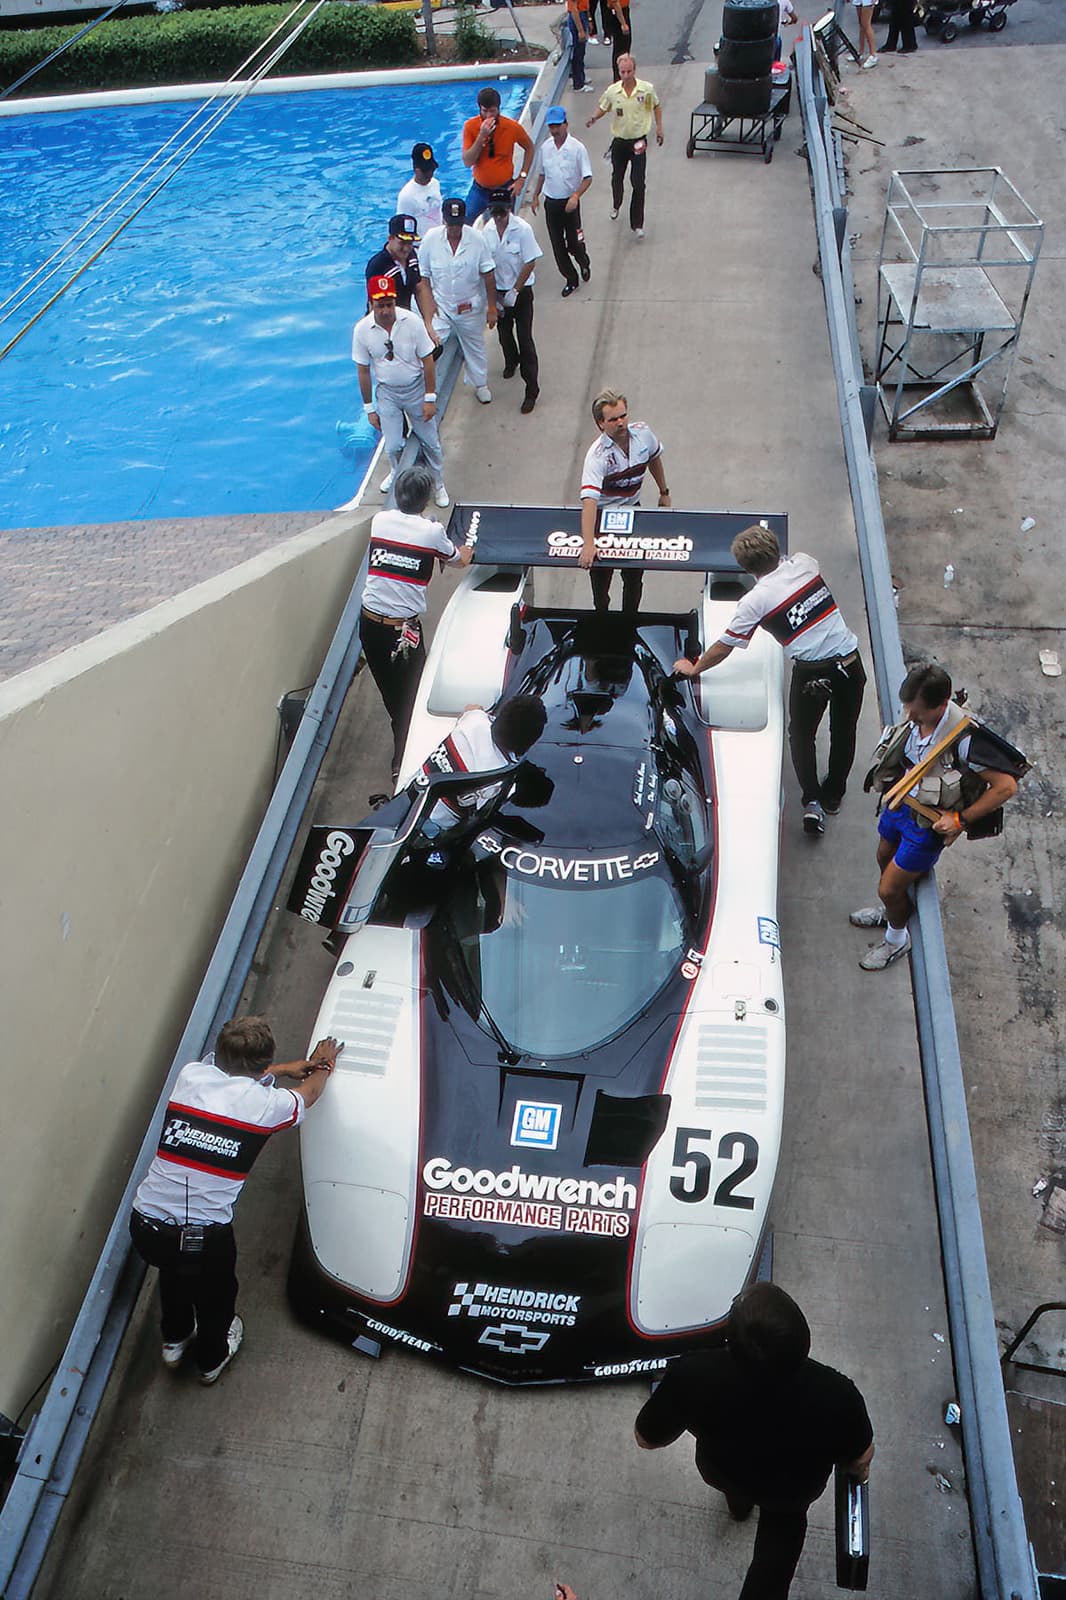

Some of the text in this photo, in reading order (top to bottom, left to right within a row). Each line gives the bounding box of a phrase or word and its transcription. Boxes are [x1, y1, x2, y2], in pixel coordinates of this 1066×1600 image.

[608, 513, 628, 525] GM
[548, 531, 693, 550] Godwrench
[549, 546, 690, 561] PERFMANCE PARTS
[500, 846, 633, 881] CORVETTE
[300, 830, 355, 924] Goodwre
[522, 1108, 551, 1131] GM
[180, 1136, 238, 1157] MOTORSPORTS
[185, 1128, 242, 1151] HENDRICK
[669, 1127, 759, 1210] 52
[423, 1158, 636, 1209] Goodwrench
[424, 1193, 629, 1236] PERFORMANCE PARTS
[484, 1286, 580, 1312] HENDRICK
[480, 1305, 577, 1326] MOTORSPORTS
[366, 1319, 431, 1352] GOODYEAR
[594, 1359, 668, 1376] GOODYEAR
